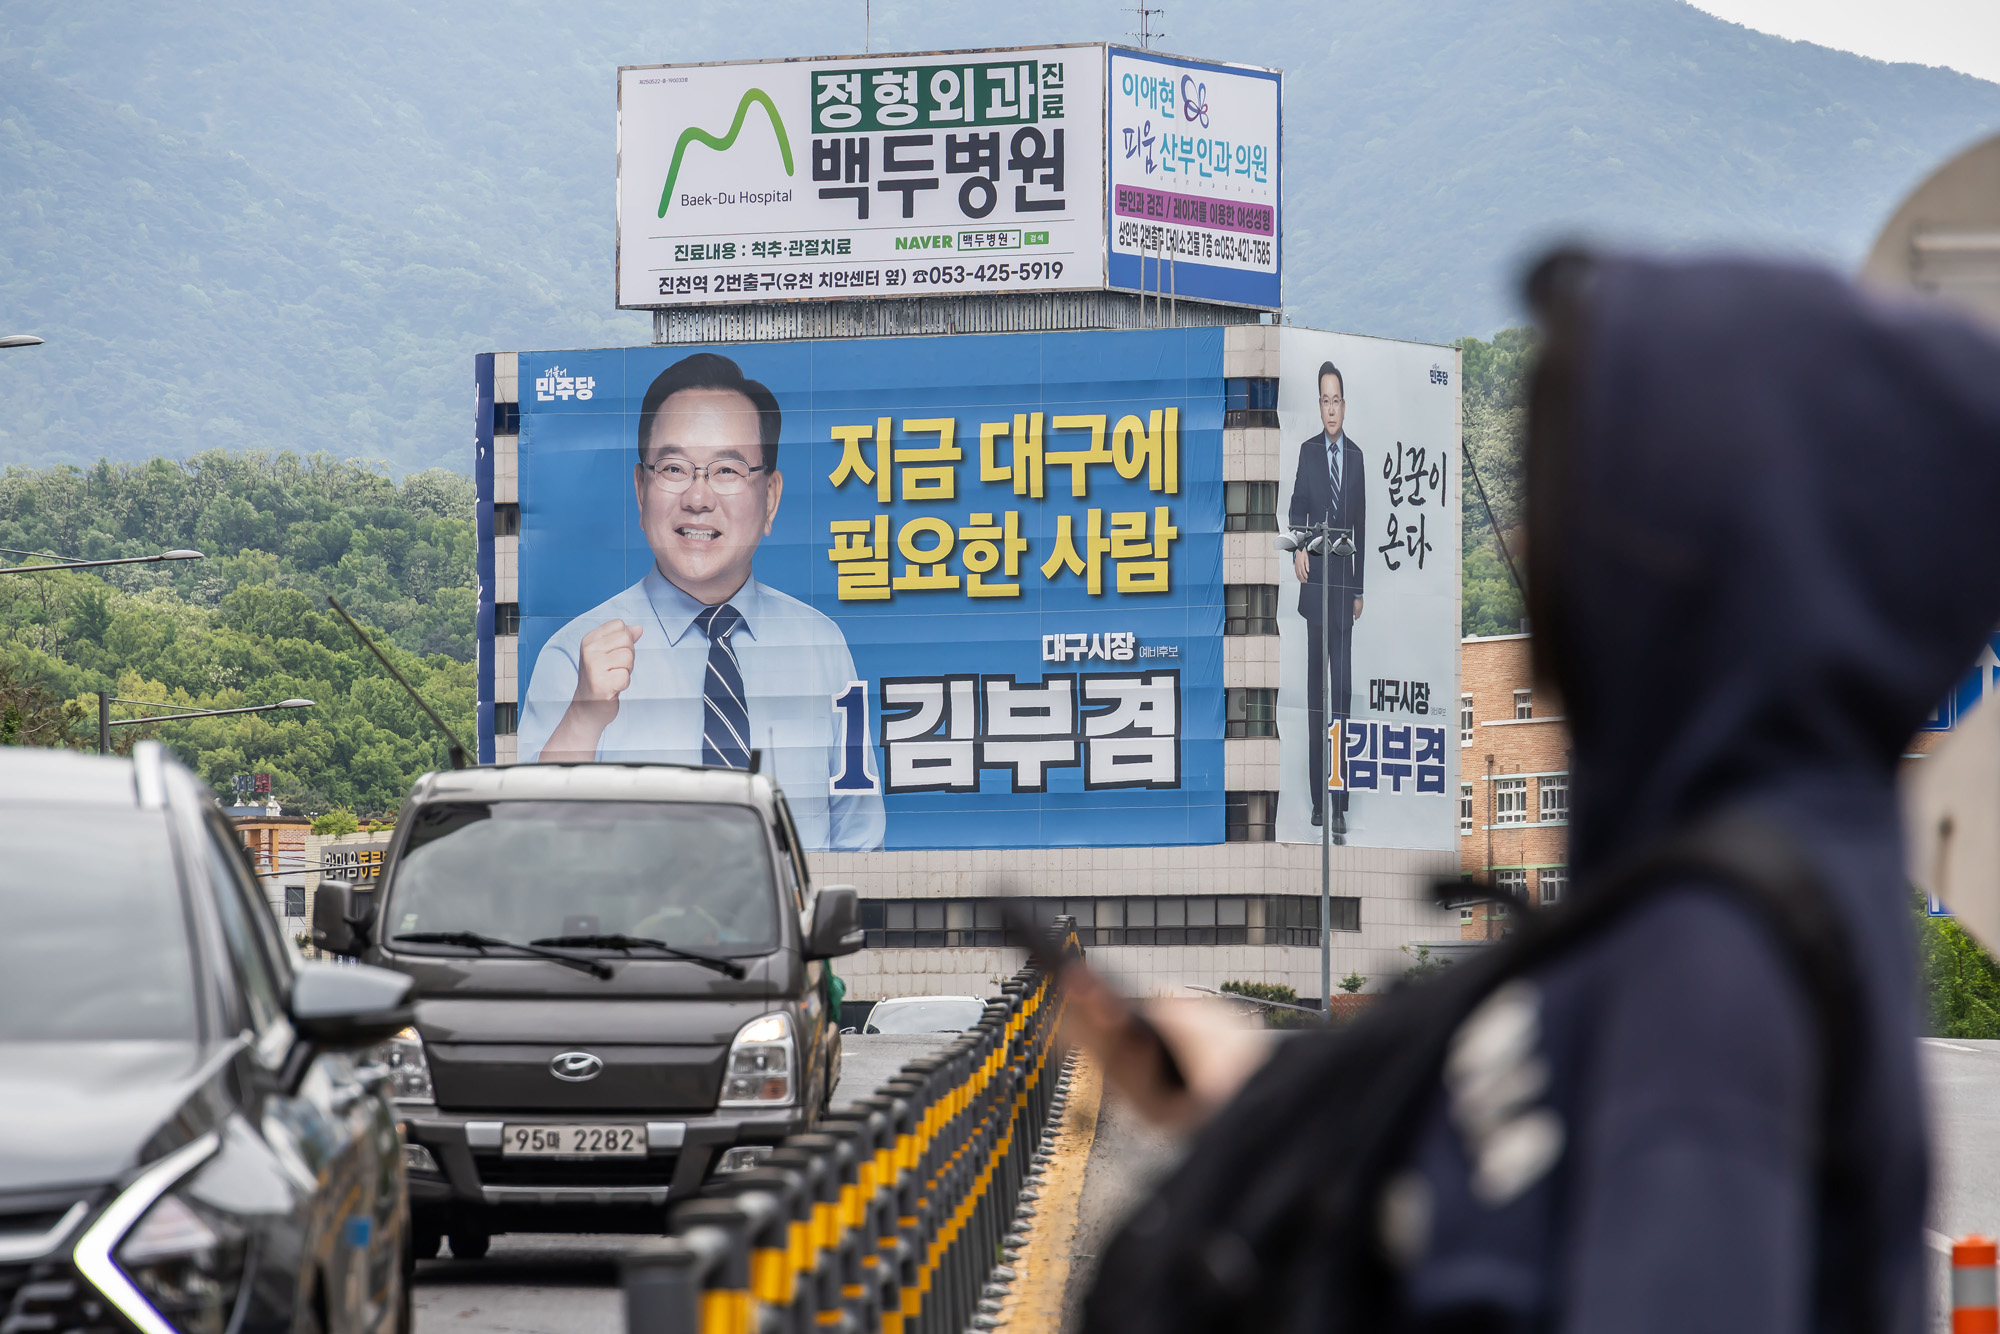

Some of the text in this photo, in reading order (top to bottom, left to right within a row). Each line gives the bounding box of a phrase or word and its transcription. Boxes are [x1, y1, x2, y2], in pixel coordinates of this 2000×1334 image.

[817, 62, 1065, 128] 정형외과 진료
[1122, 73, 1175, 118] 이애현
[1122, 120, 1157, 175] 피움
[812, 126, 1065, 219] 백두병원
[681, 189, 792, 206] Baek-Du Hospital
[1119, 189, 1144, 213] 부인과
[1147, 193, 1164, 217] 검진
[1173, 199, 1207, 223] 레이저를
[1209, 203, 1235, 227] 이용한
[1237, 206, 1270, 232] 여성성형
[674, 242, 736, 262] 진료내용
[751, 238, 852, 259] 척추·관절치료
[895, 232, 1044, 250] NAVER 백두병원 검색
[1119, 221, 1139, 248] 상인역
[1202, 232, 1213, 258] 7층
[1220, 235, 1271, 266] 053-421-7585
[658, 261, 1064, 295] 진천역 2번출구(유천 치안센터 옆) 053-425-5919
[535, 376, 596, 402] 민주당
[1429, 369, 1449, 386] 민주당
[828, 407, 1178, 503] 지금 대구에
[1383, 441, 1447, 507] 일꾼이
[827, 505, 1178, 600] 필요한 사람
[1378, 512, 1433, 571] 온다
[1042, 631, 1179, 662] 대구시장 예비후보
[1369, 678, 1431, 715] 대구시장
[829, 669, 1181, 795] 1 김부겸
[1328, 718, 1447, 798] 1 김부겸
[324, 850, 387, 879] 한마음동물
[515, 1128, 634, 1151] 95마 2282
